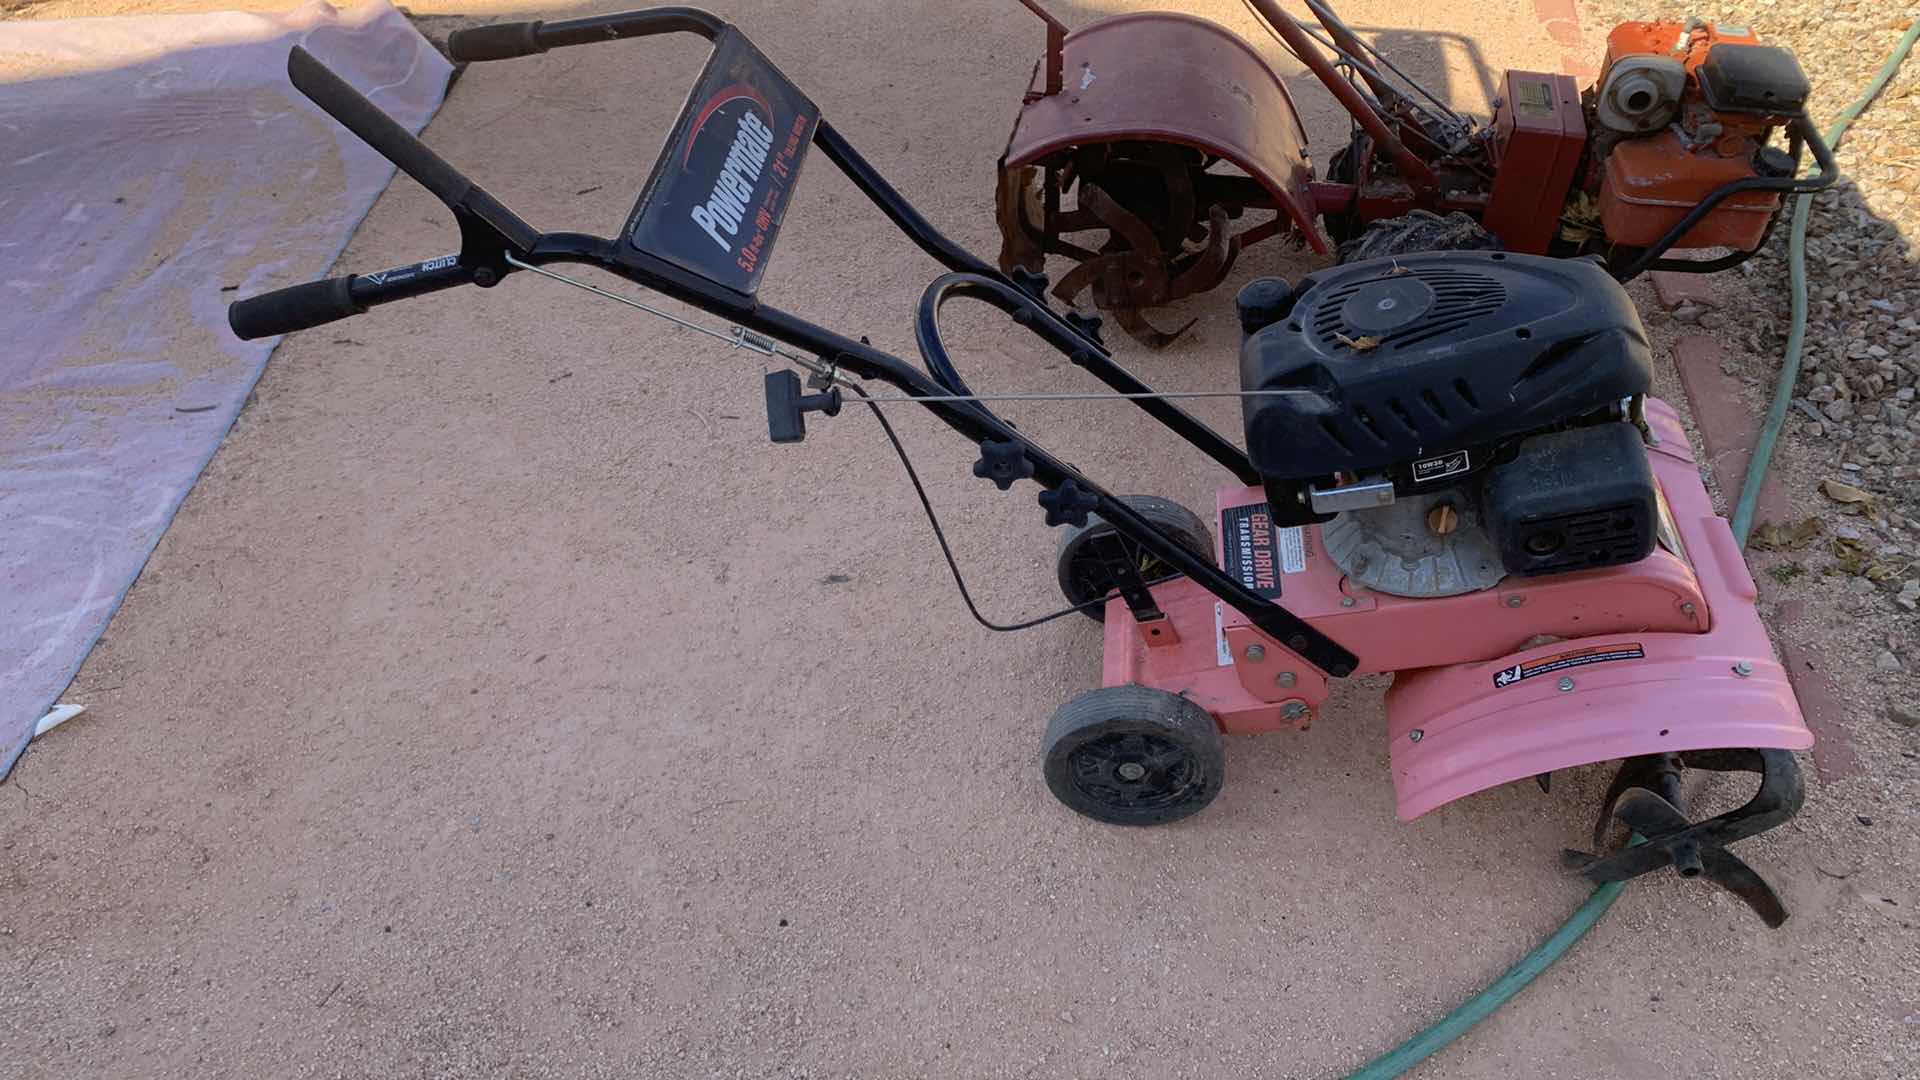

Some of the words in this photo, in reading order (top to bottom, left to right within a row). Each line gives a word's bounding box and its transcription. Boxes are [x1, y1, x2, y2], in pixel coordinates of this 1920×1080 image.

[691, 111, 774, 252] Powermate
[423, 256, 457, 271] CLUTCH
[737, 247, 758, 272] 5.0
[1418, 460, 1443, 470] 10W30
[1252, 513, 1270, 546] GEAR
[1254, 550, 1274, 588] DRIVE
